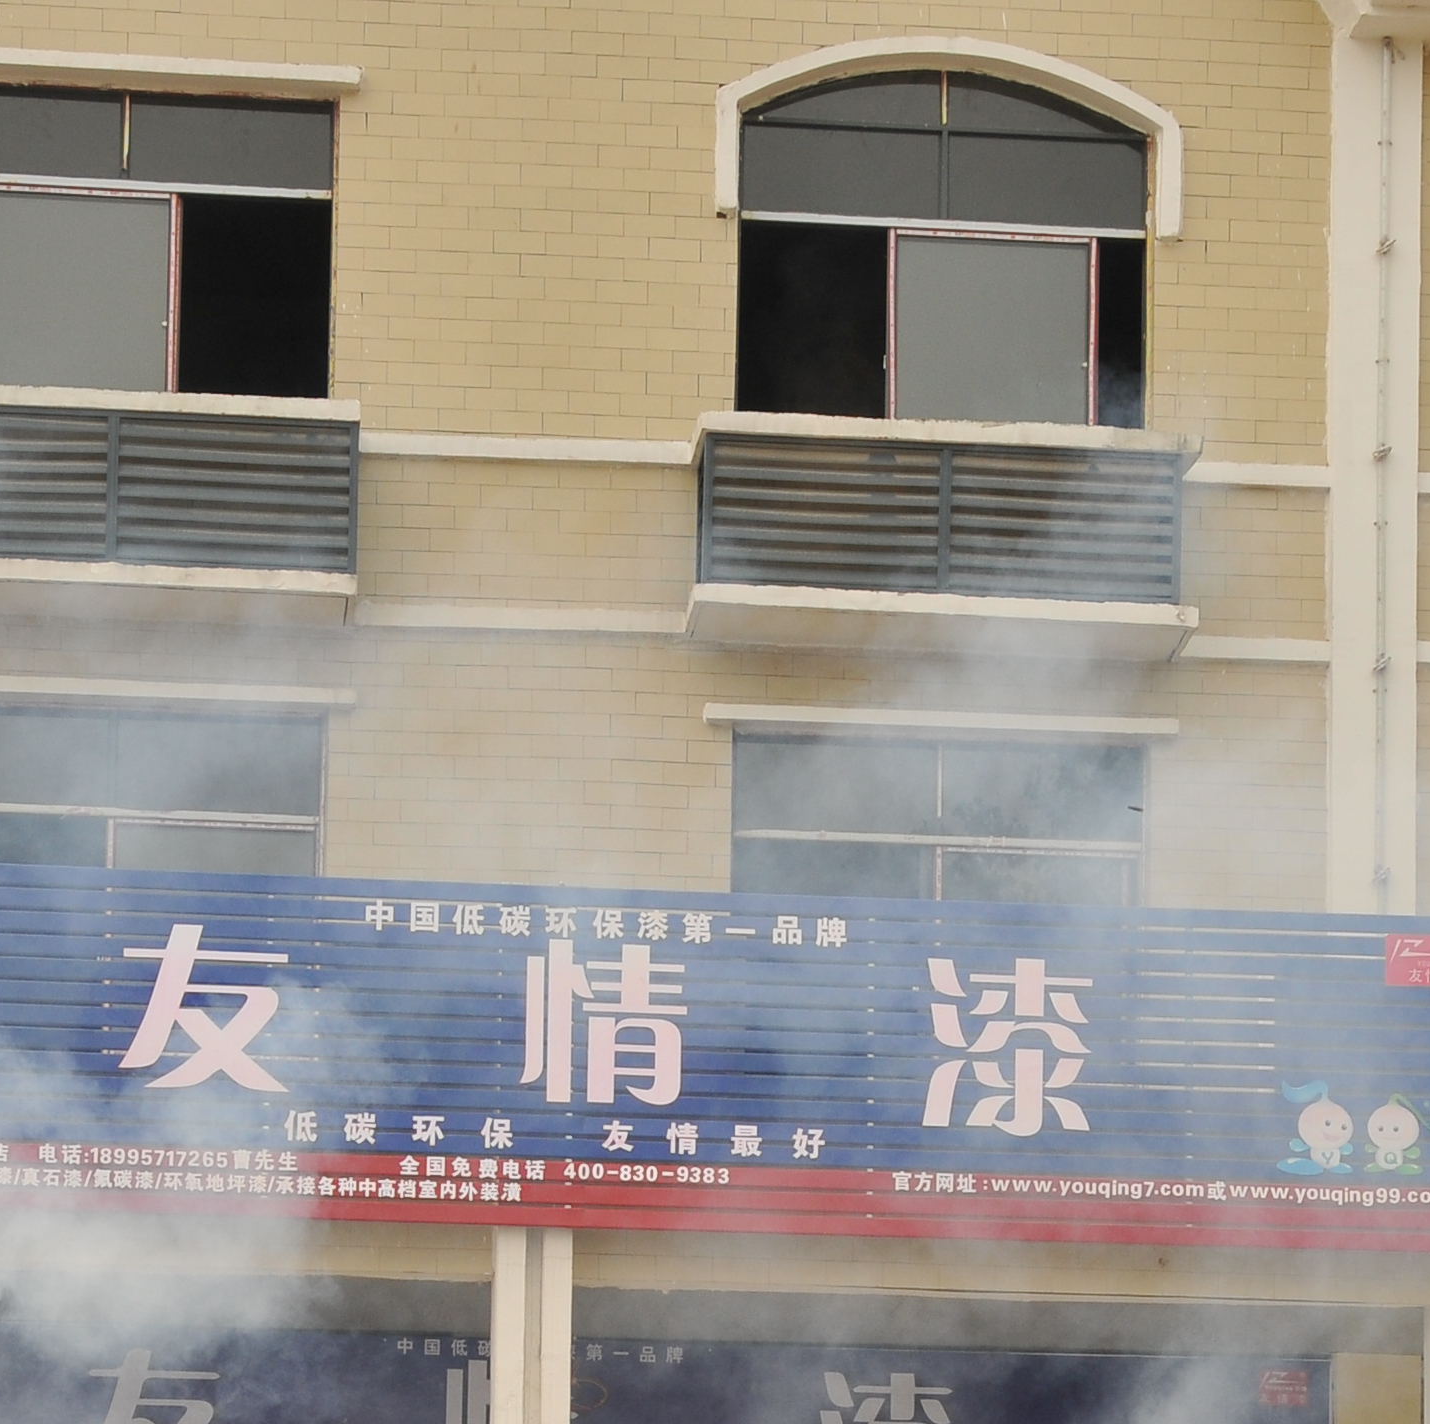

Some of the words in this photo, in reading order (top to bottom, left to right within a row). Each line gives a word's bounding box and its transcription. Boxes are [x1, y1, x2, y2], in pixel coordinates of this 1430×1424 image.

[365, 899, 848, 948] 中国低碳环保漆第一品牌
[118, 923, 1094, 1138] 友情漆
[284, 1110, 514, 1149] 低碳环保
[601, 1120, 826, 1159] 友情最好
[399, 1155, 546, 1181] 全国免费电话
[564, 1162, 731, 1185] 400-830-9383
